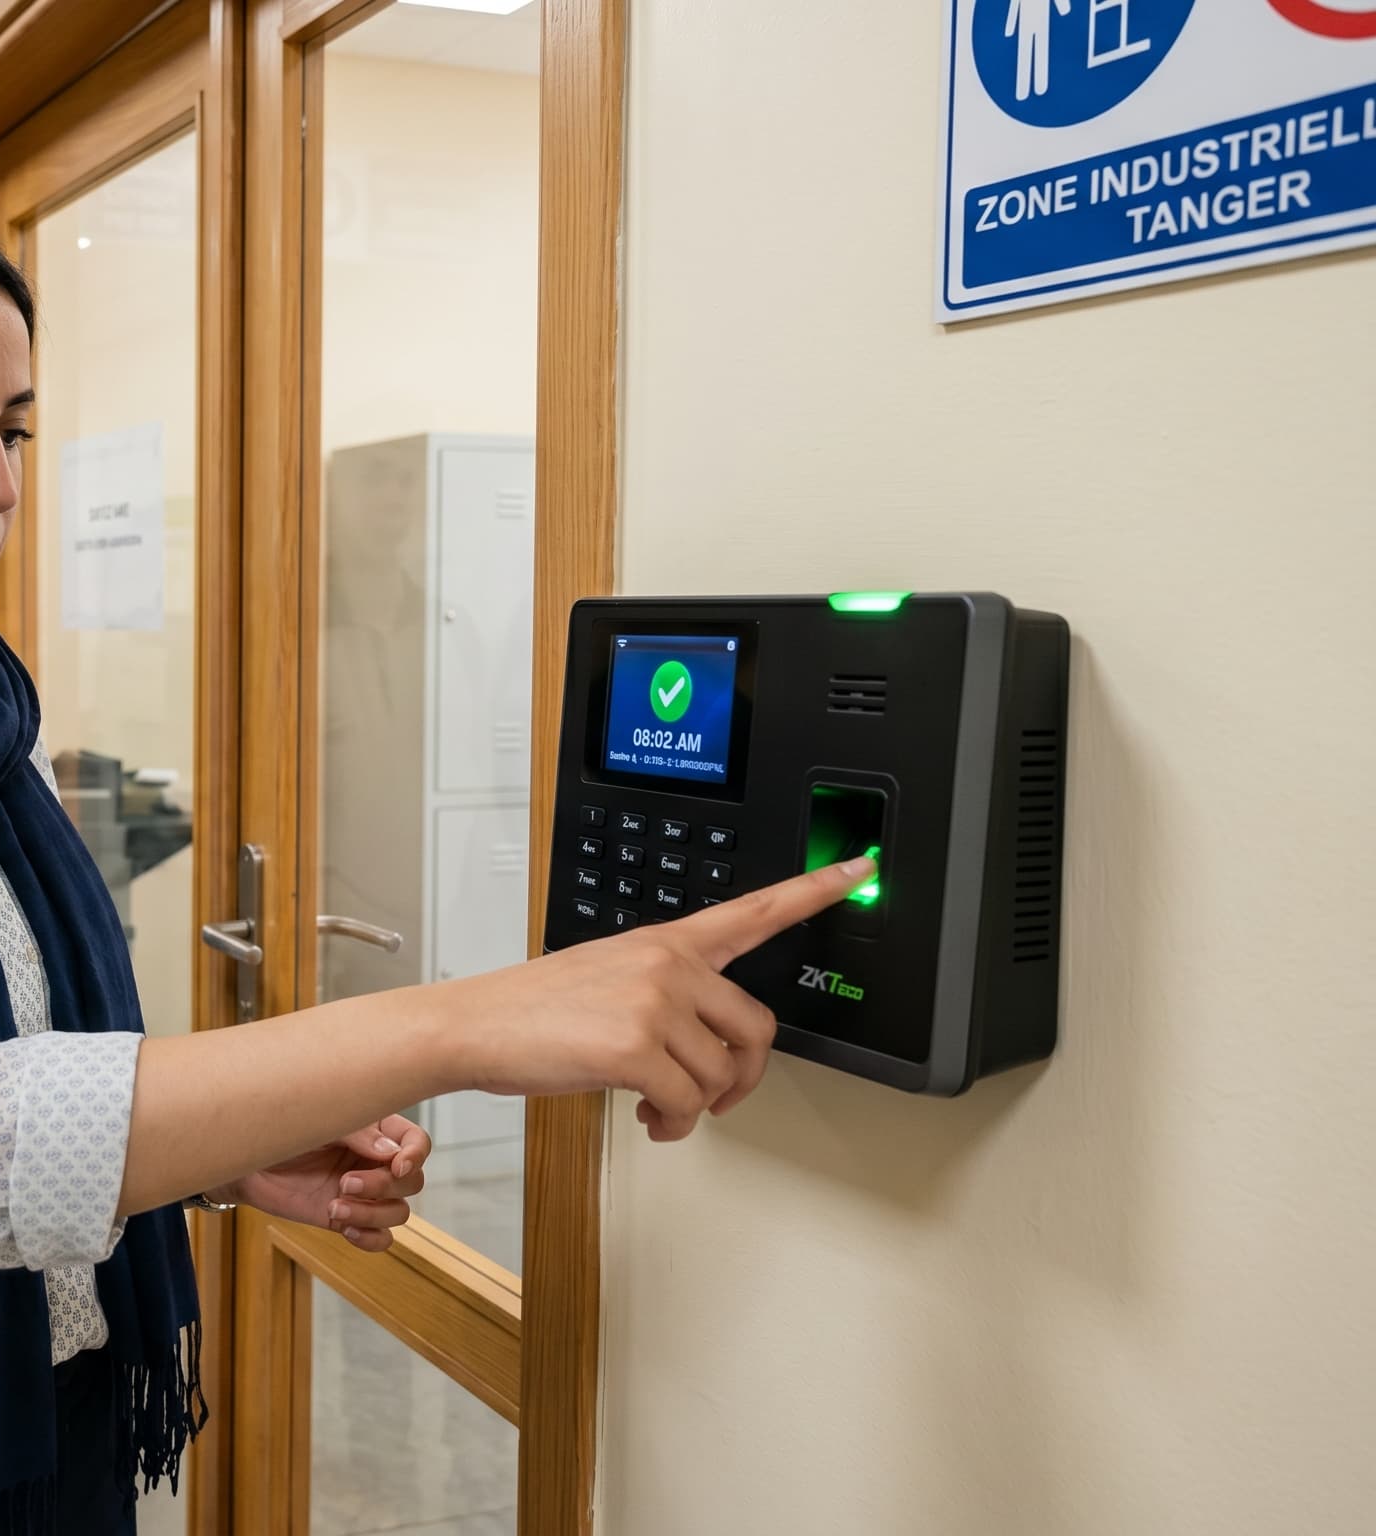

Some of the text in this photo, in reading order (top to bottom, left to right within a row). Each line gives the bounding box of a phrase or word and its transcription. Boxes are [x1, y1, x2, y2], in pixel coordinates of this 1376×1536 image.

[975, 175, 1078, 233] ZONE
[1126, 170, 1312, 244] TANGER
[633, 727, 673, 750] 08:02
